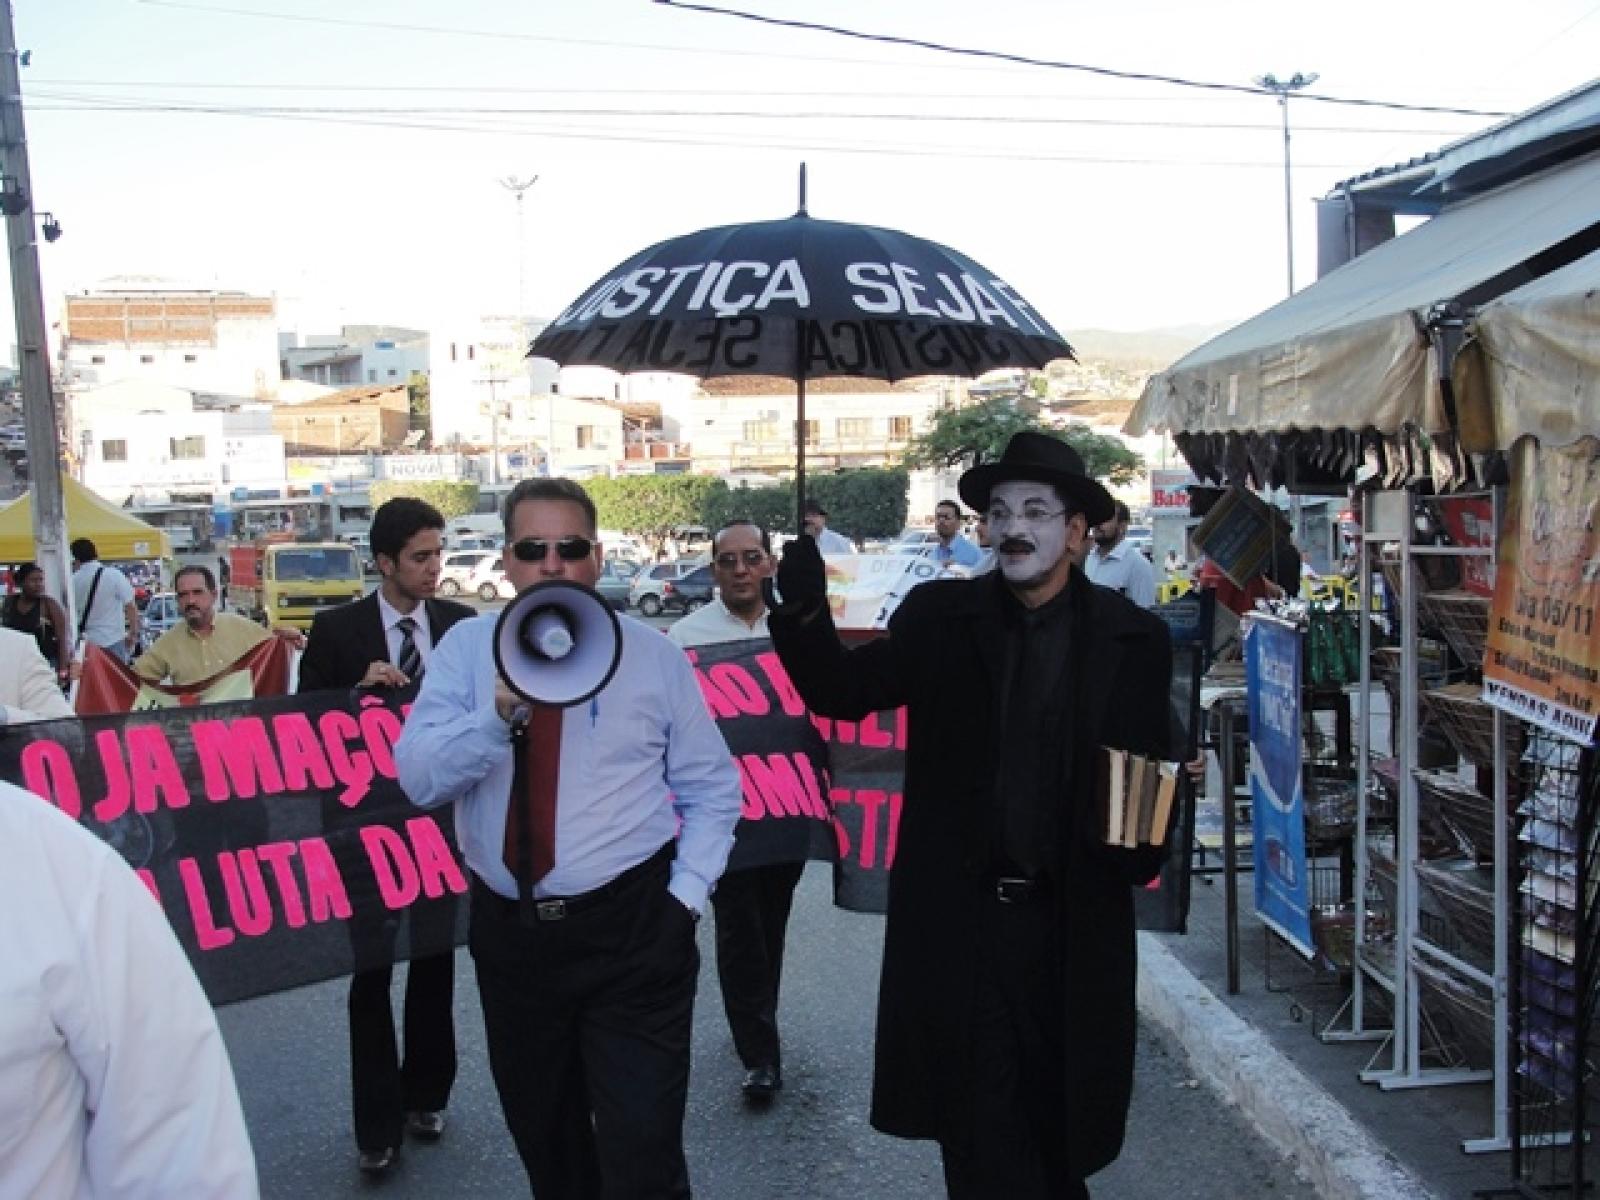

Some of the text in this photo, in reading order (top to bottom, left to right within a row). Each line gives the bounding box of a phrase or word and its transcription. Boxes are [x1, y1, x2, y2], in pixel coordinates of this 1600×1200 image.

[844, 261, 1019, 329] SEJA
[93, 723, 191, 823] JA
[190, 694, 413, 808] MAÇÕ
[179, 836, 354, 950] LUTA
[358, 815, 469, 911] DA
